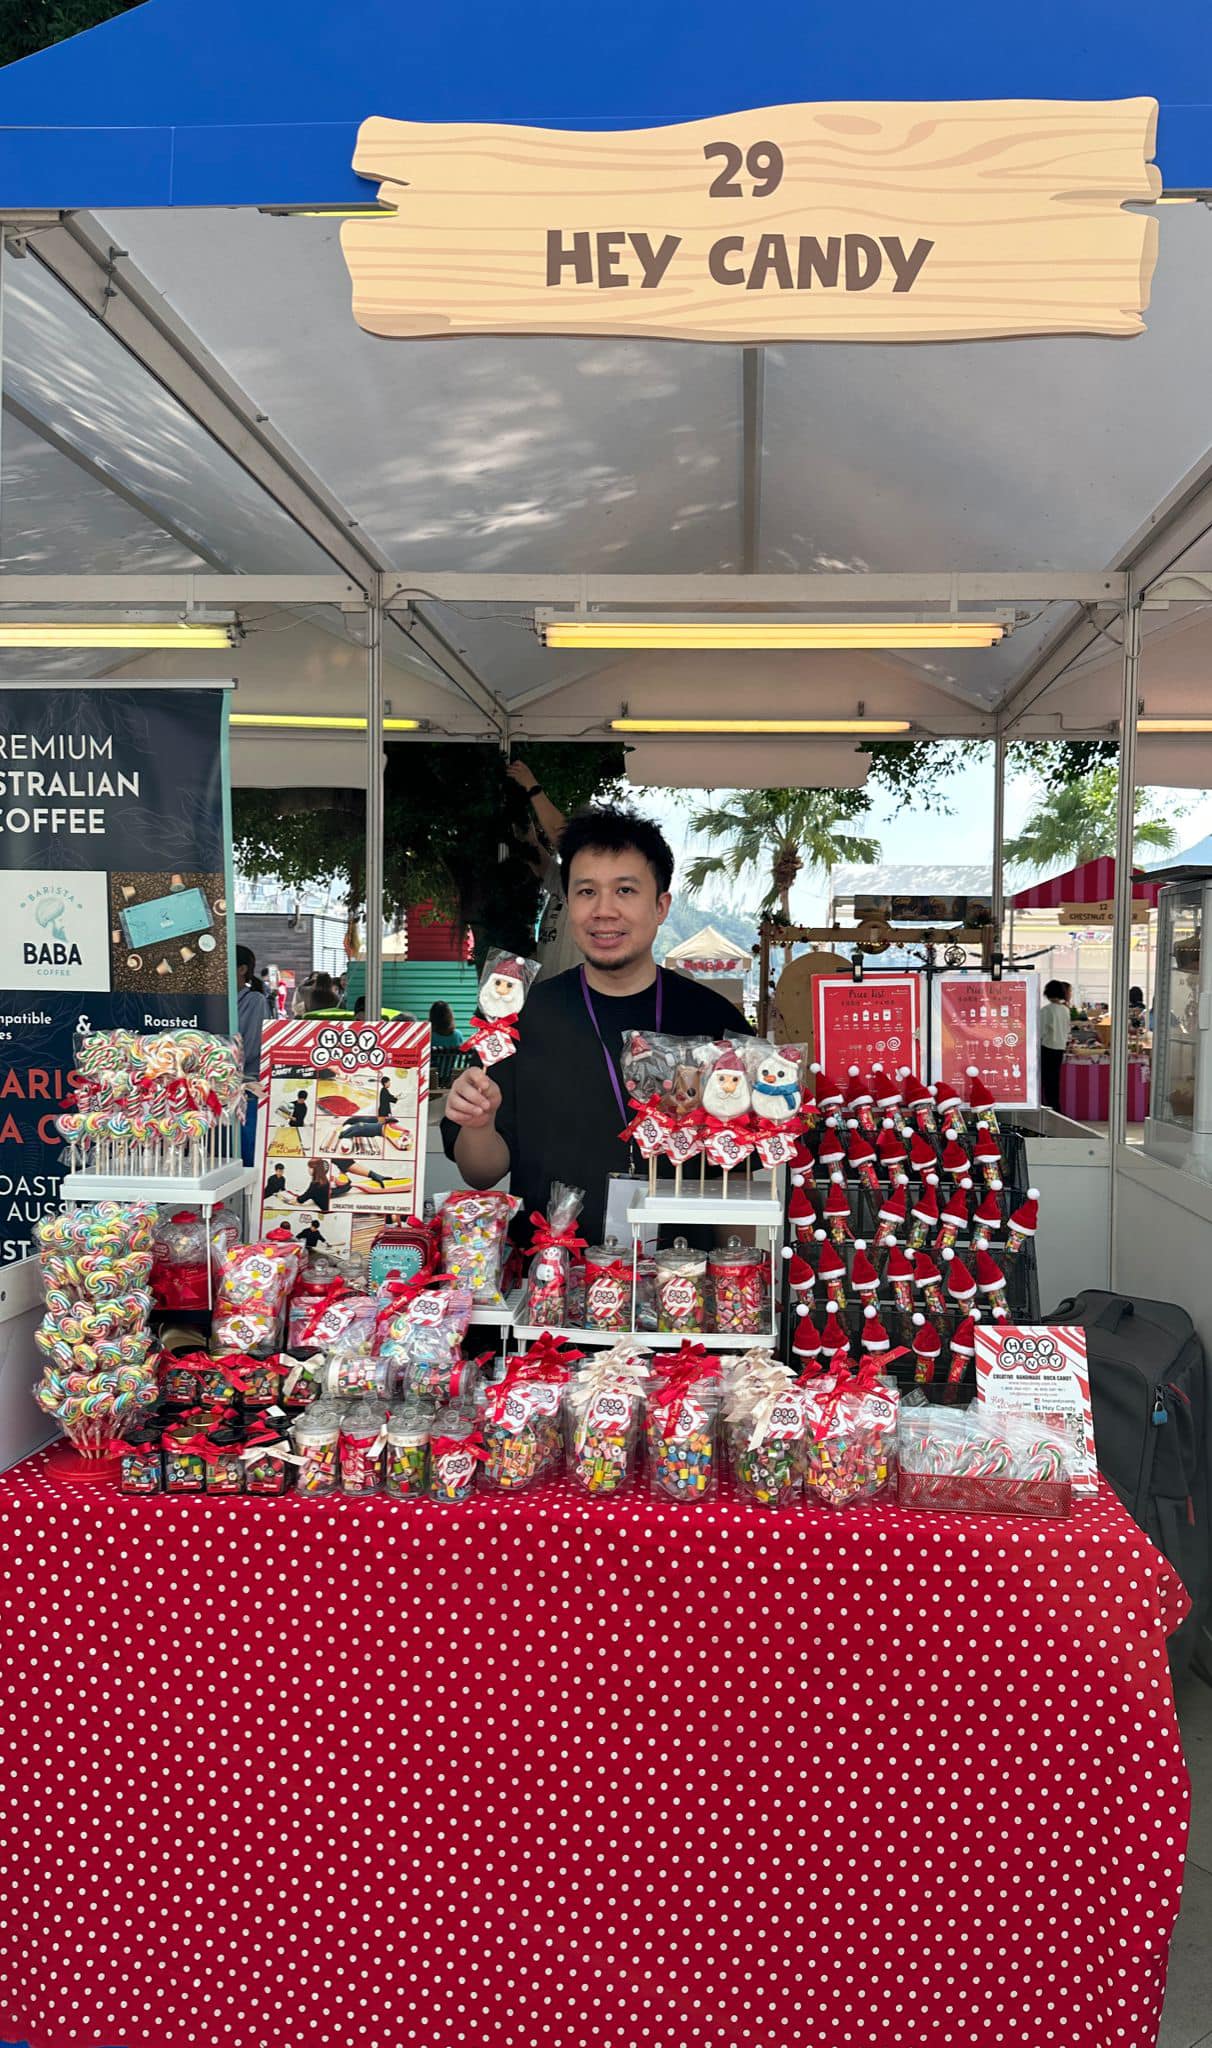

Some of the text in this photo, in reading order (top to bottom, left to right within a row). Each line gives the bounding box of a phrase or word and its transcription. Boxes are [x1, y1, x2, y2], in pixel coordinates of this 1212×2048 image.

[703, 141, 784, 198] 29
[546, 229, 935, 292] HEY CANDY
[0, 808, 106, 834] OFFEE
[27, 886, 76, 902] BARISTA
[1069, 913, 1106, 921] CHESTNUT
[23, 942, 82, 966] BABA
[37, 968, 71, 977] COFFEE
[144, 1015, 198, 1028] Roasted
[321, 1031, 375, 1049] HEY
[314, 1048, 383, 1066] CANDY
[1006, 1339, 1052, 1353] HEY
[1002, 1353, 1061, 1368] CANDY
